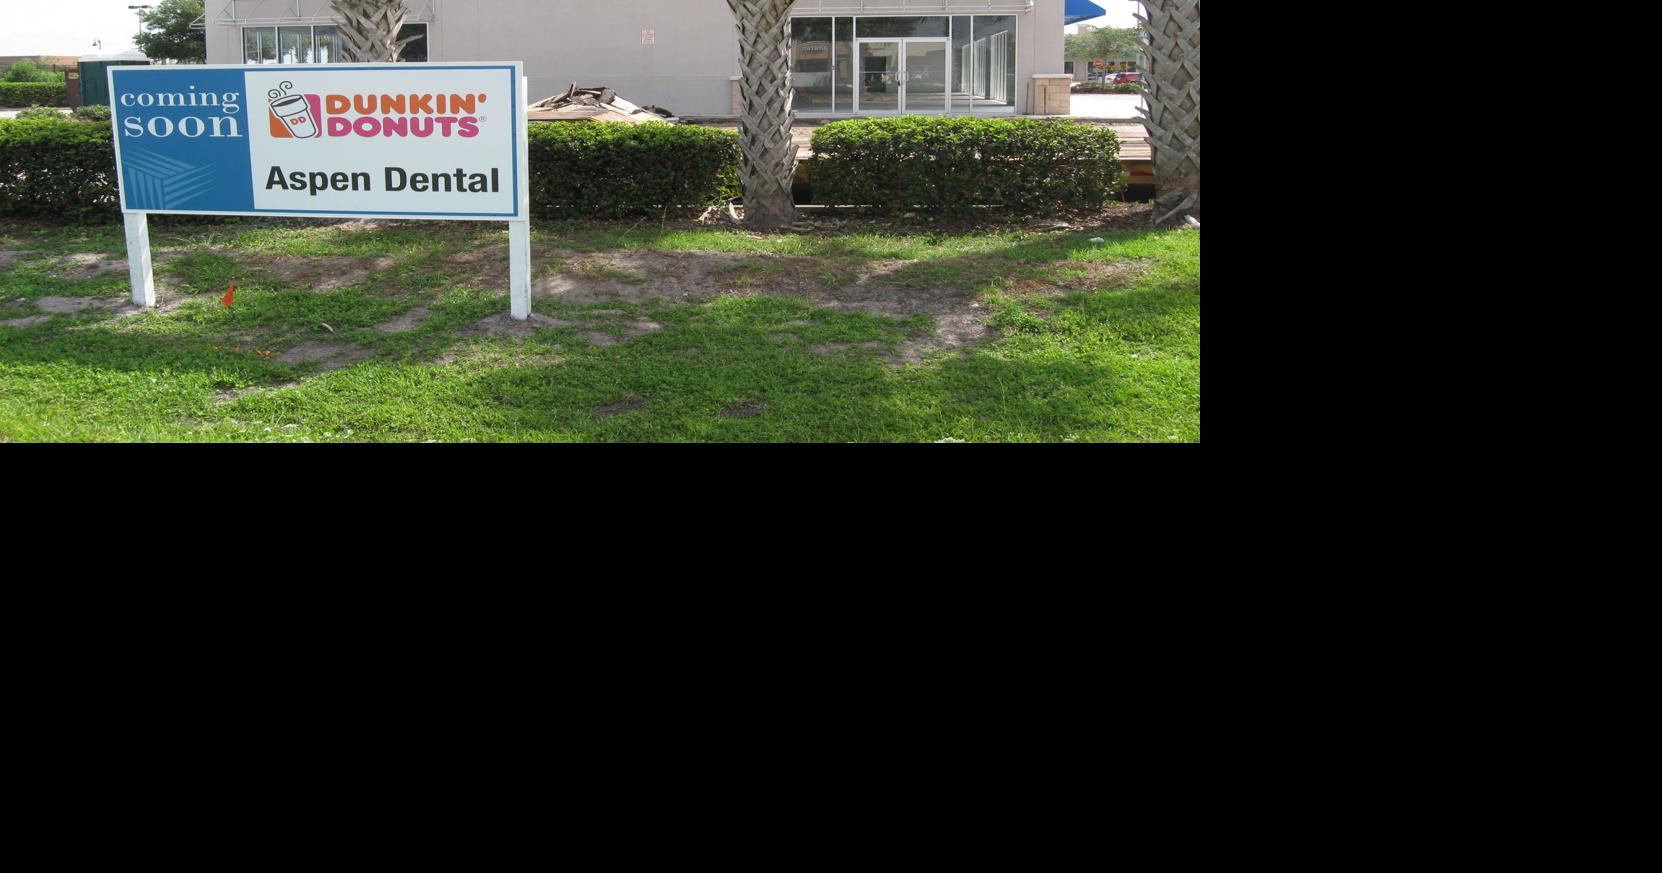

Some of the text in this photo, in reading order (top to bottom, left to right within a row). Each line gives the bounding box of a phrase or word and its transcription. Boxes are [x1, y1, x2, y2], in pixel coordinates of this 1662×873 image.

[121, 85, 240, 114] coming
[325, 93, 487, 115] DUNKIN'
[124, 114, 243, 138] soon
[290, 116, 306, 125] DD
[327, 116, 480, 138] DONUTS
[265, 166, 499, 196] Aspen Dental
